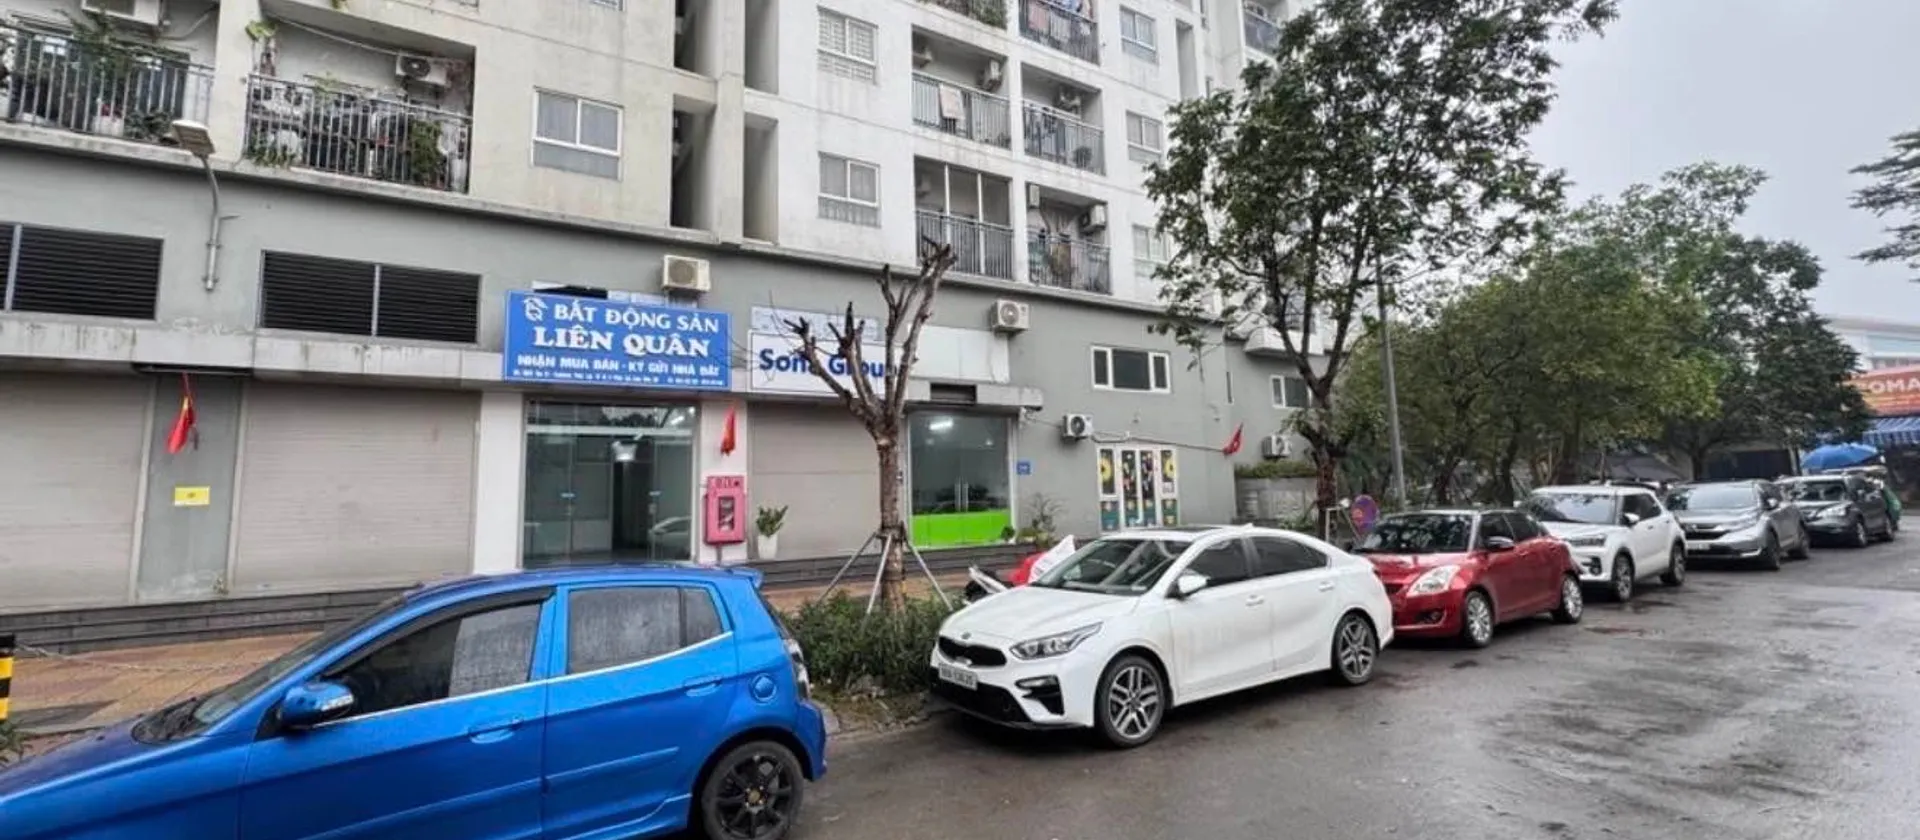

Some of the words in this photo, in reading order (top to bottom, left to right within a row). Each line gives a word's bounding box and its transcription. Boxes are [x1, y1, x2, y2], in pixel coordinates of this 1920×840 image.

[605, 307, 670, 330] ĐỘNG
[677, 312, 719, 333] SẢN
[533, 325, 614, 351] LIÊN
[623, 332, 711, 357] QUÂN
[560, 357, 589, 369] MUA
